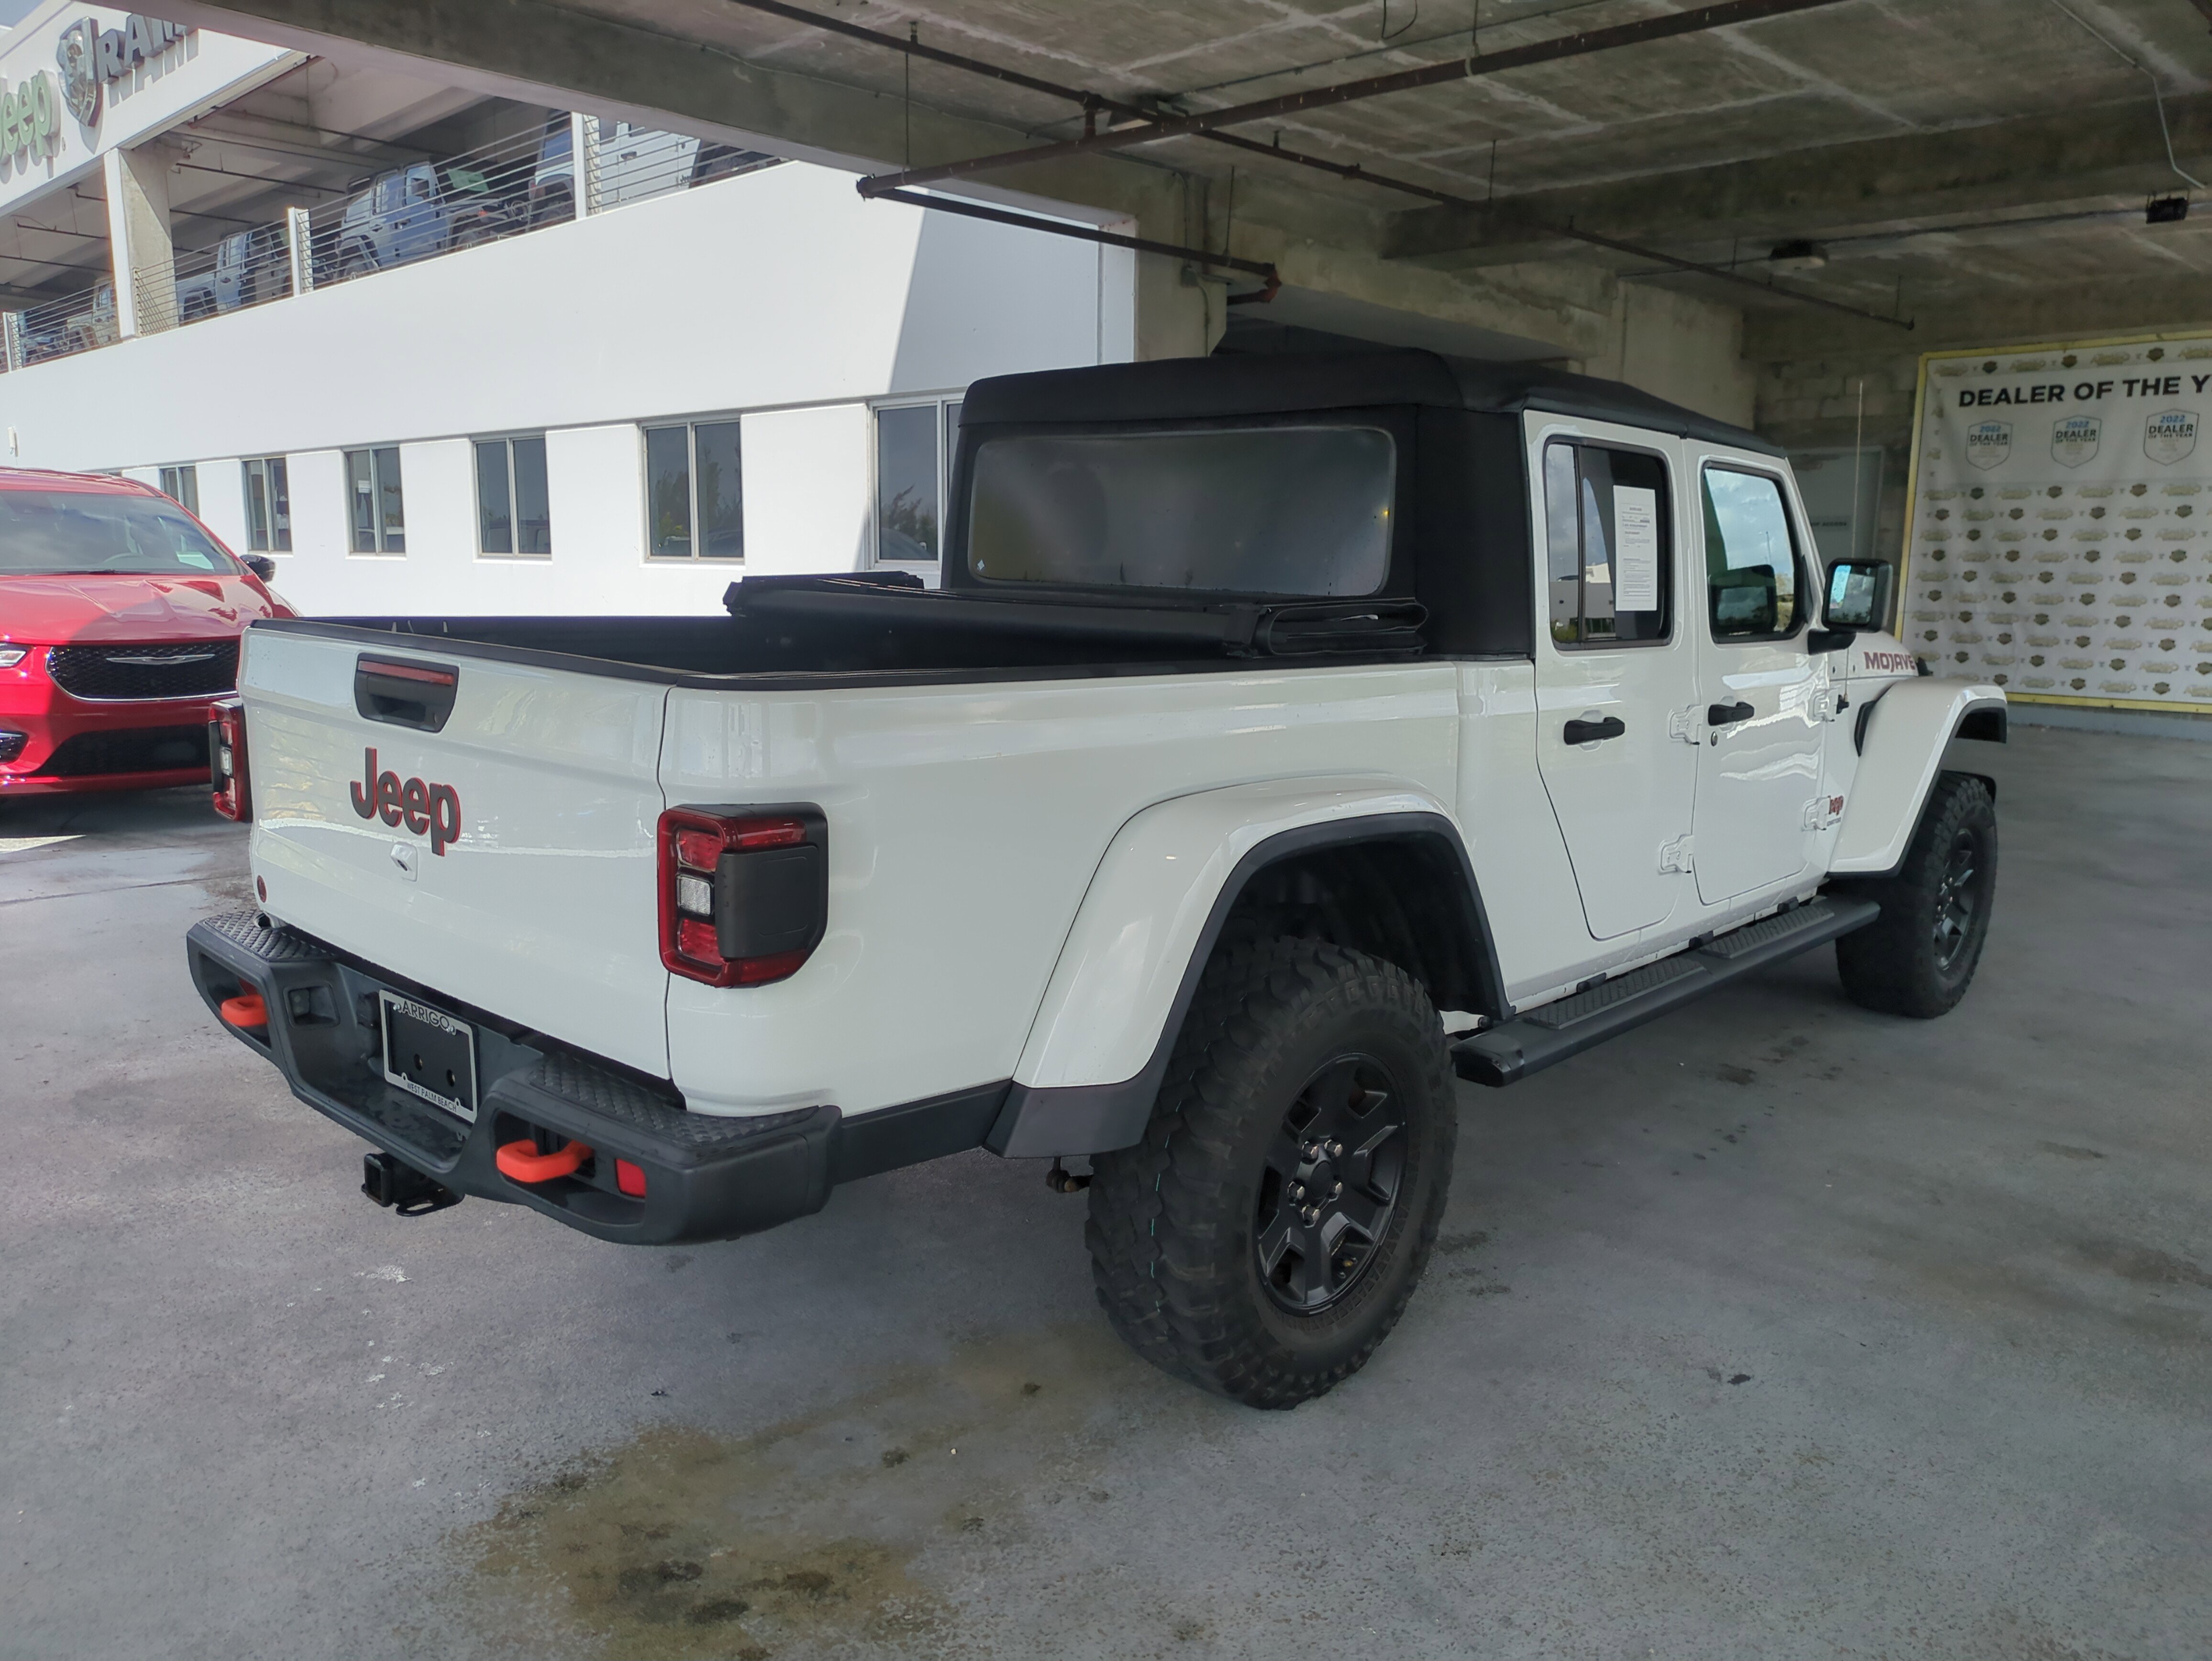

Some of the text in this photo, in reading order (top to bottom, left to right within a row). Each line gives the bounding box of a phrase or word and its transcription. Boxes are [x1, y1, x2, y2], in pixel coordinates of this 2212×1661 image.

[0, 69, 52, 158] eep
[1959, 374, 2212, 407] DEALER OF THE Y
[2066, 421, 2090, 429] 2022
[2149, 424, 2193, 434] DEALER
[2160, 414, 2185, 423] 2022
[1970, 433, 2008, 442] DEALER
[2056, 429, 2096, 438] DEALER
[1864, 651, 1915, 673] MOJAVE
[350, 747, 461, 856] Jeep
[403, 1000, 450, 1030] ARRIGO
[407, 1082, 457, 1112] WEST PALM BEACH
